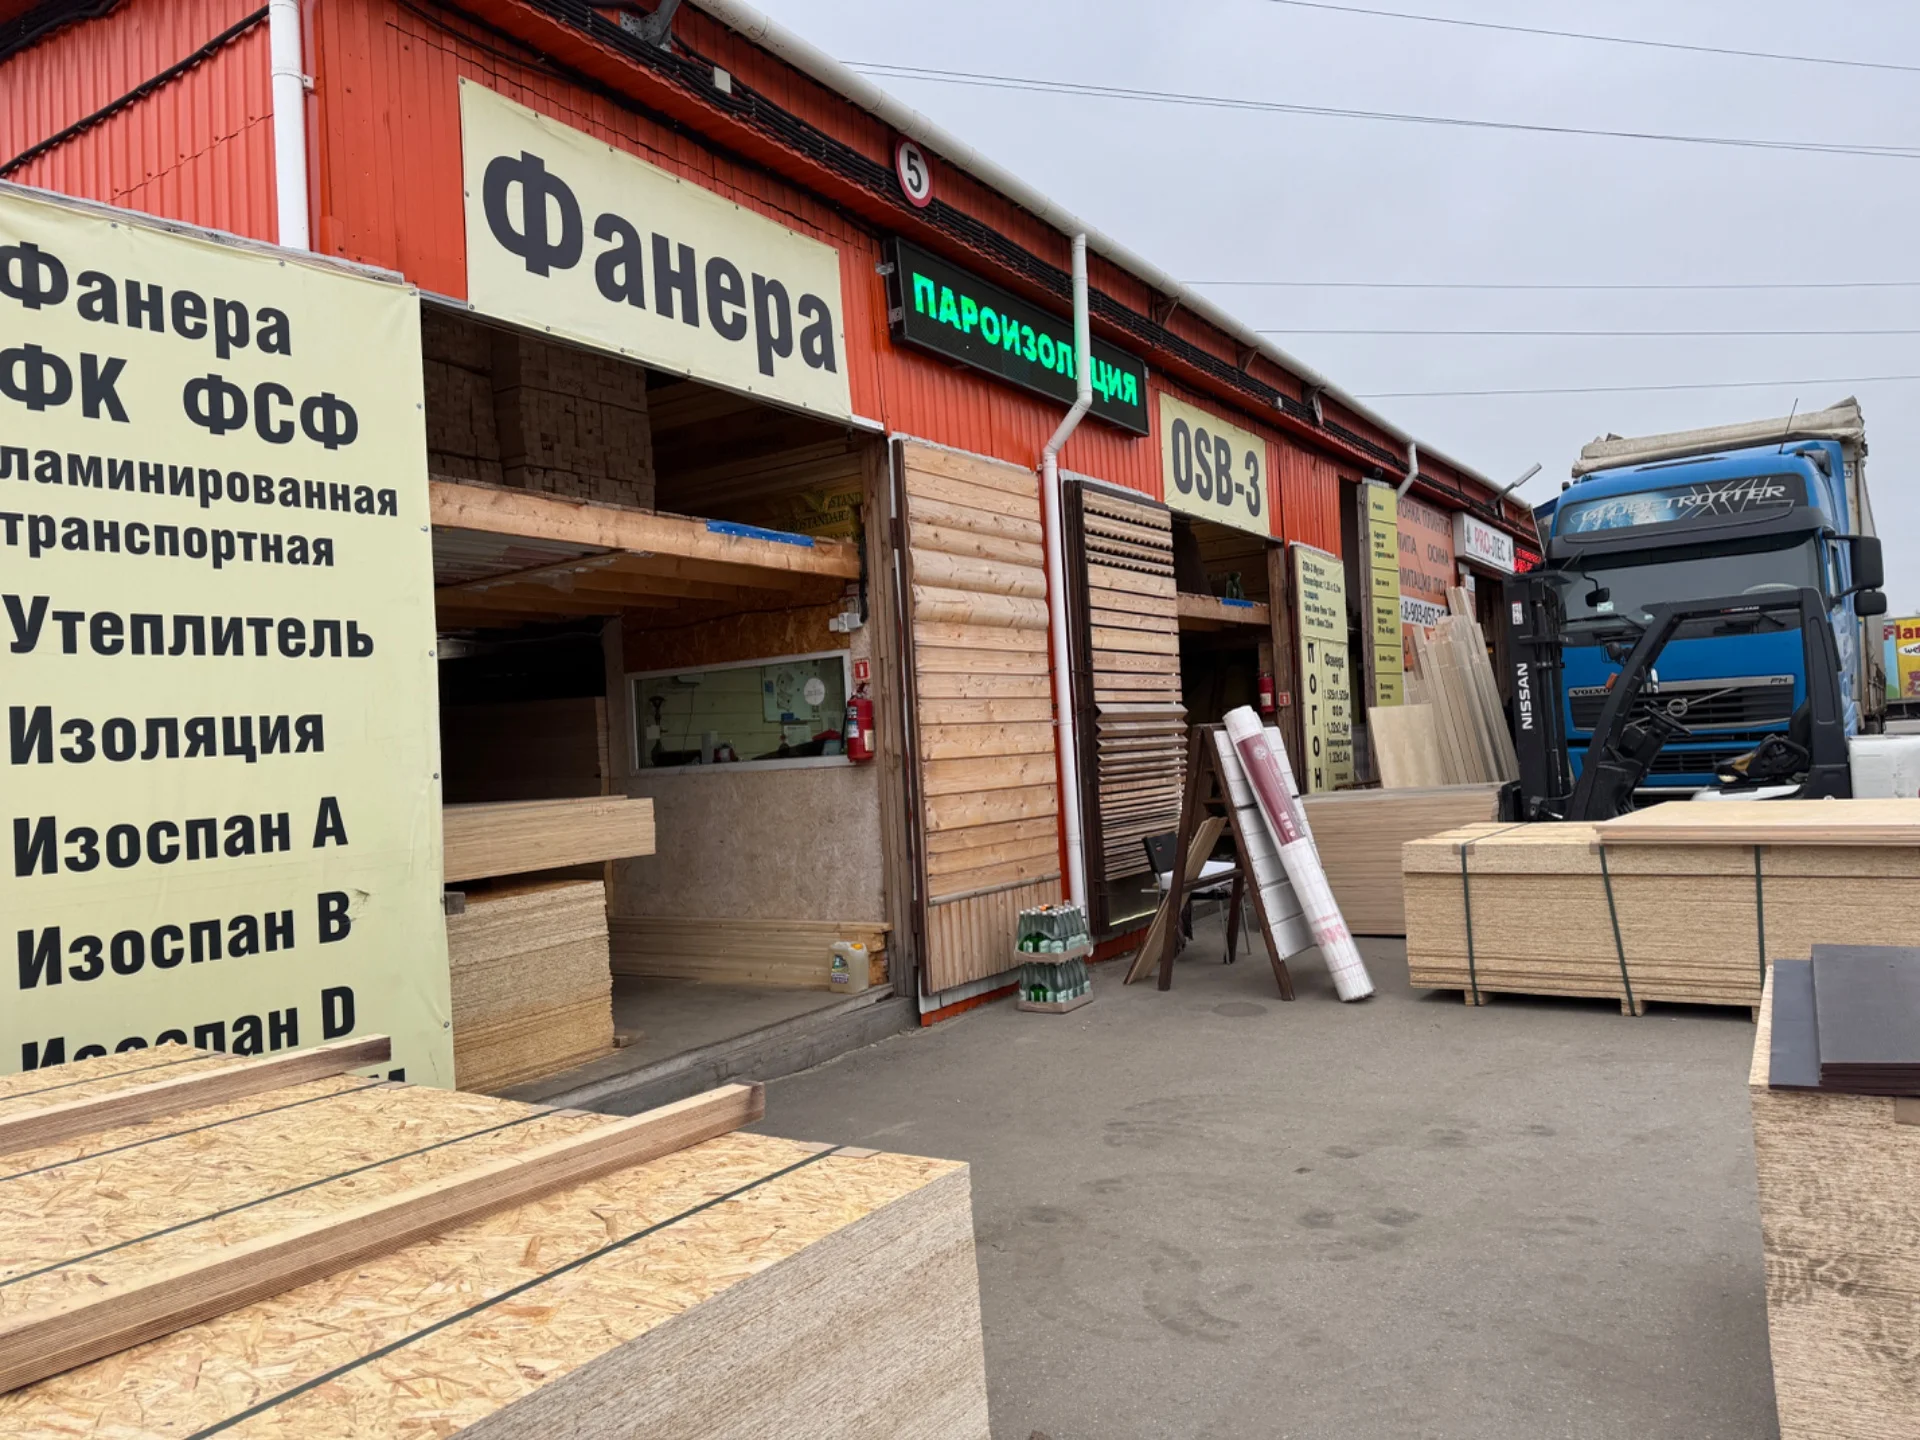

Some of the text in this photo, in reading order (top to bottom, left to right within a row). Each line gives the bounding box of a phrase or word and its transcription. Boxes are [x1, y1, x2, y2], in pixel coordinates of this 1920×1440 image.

[907, 150, 923, 193] 5
[482, 150, 838, 377] Фанера
[0, 241, 292, 360] Фанера
[912, 273, 1138, 406] ПАРОИЗОЛЦИЯ
[0, 343, 358, 450] ФК ФСФ
[0, 445, 398, 517] ламинированная
[1172, 417, 1261, 518] OSB-3
[0, 511, 334, 570] транспортная
[1, 594, 375, 658] Утеплитель
[1516, 662, 1533, 730] NISSAN
[1572, 688, 1611, 696] VOLVO
[9, 705, 325, 765] Изоляция
[14, 812, 291, 877] Изоспан
[17, 910, 295, 990] Изоспан
[21, 985, 356, 1072] Ипан D
